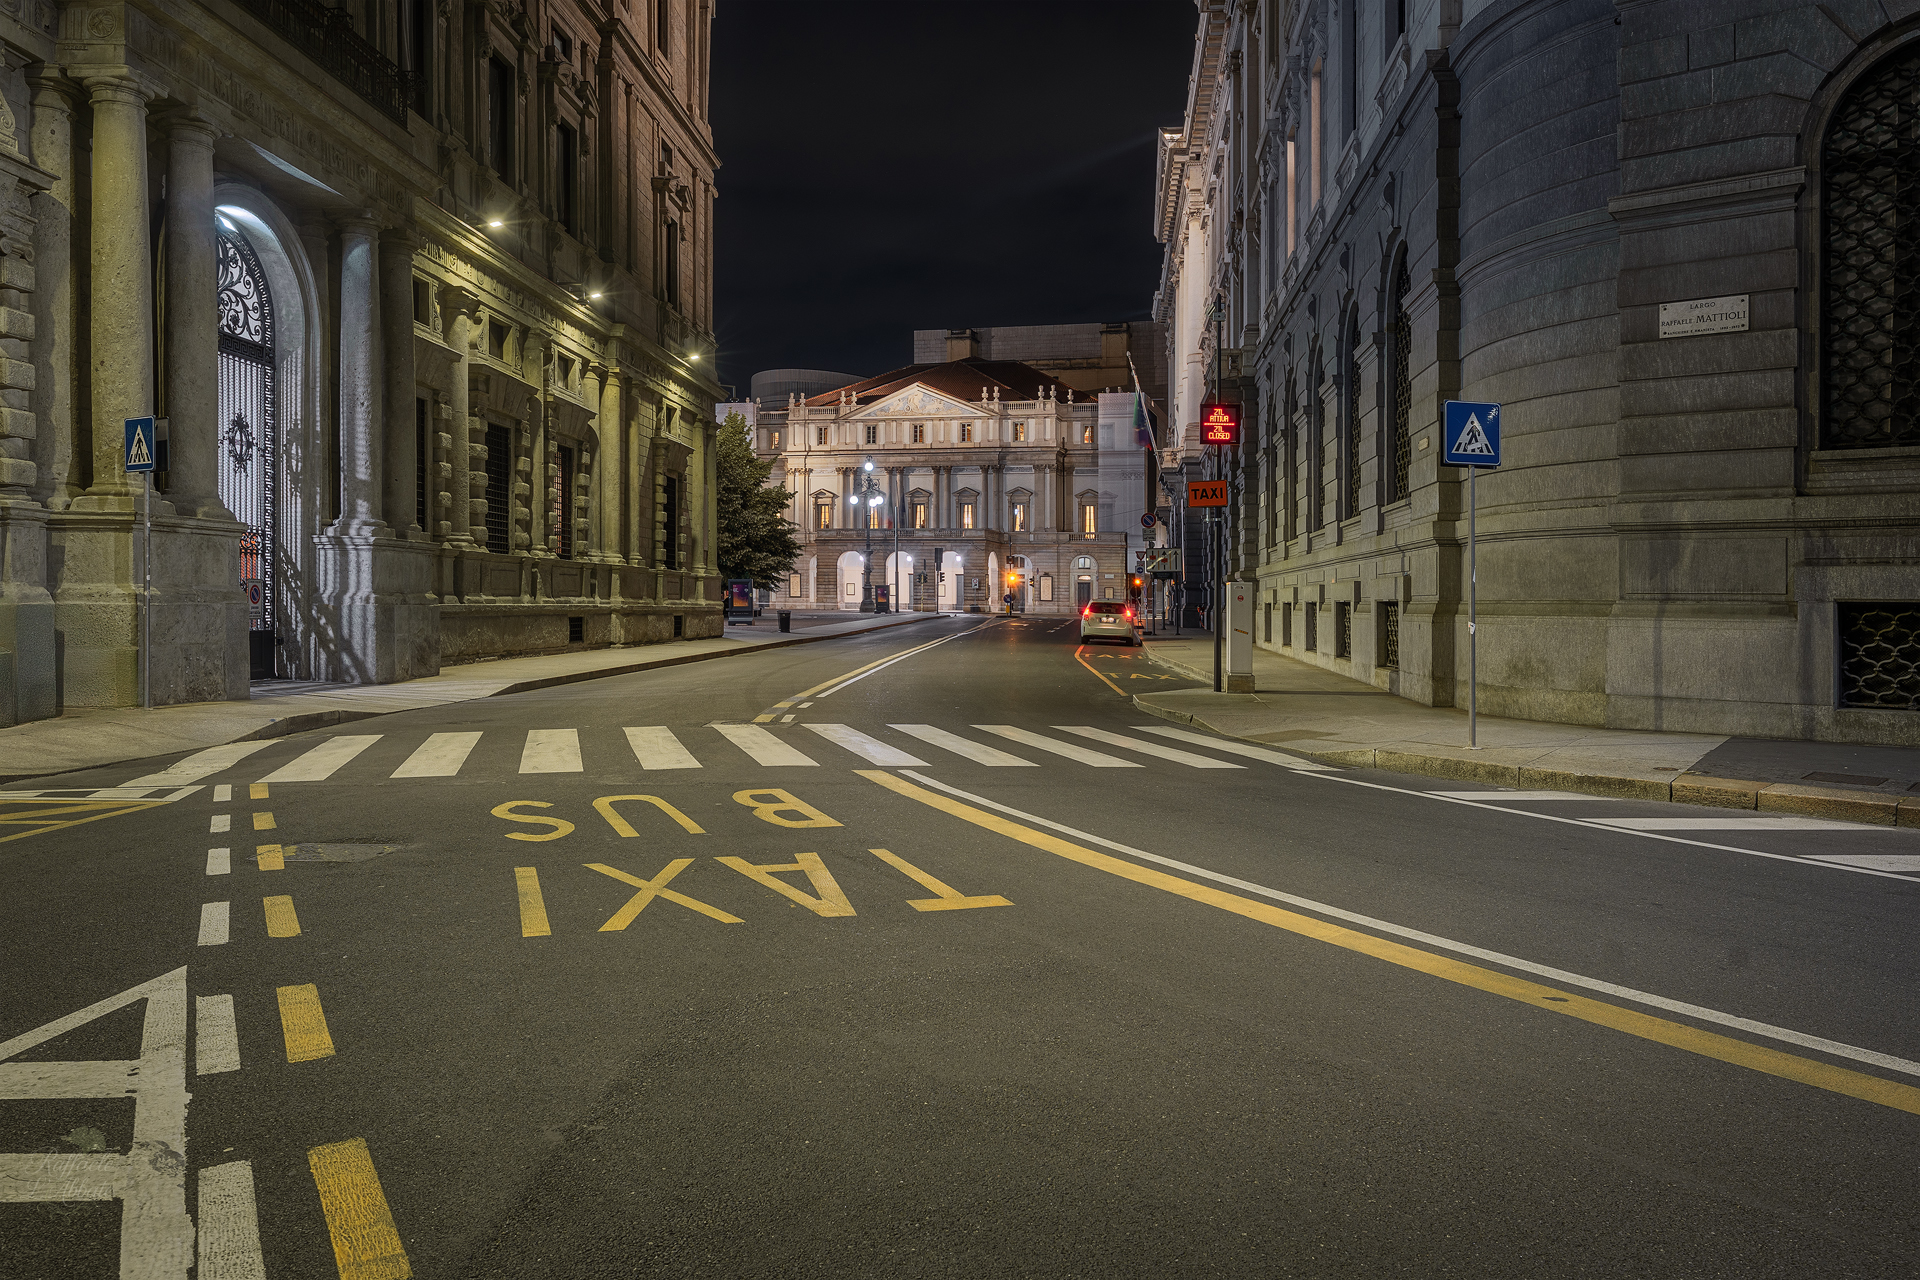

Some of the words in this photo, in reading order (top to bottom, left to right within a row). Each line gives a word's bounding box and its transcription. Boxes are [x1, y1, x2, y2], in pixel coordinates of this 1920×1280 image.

[1661, 319, 1693, 327] RAFFAELE
[1696, 311, 1746, 323] MATTIOLI
[1208, 432, 1231, 440] CLOSED
[1191, 487, 1223, 500] TAXI
[1102, 672, 1195, 681] TAXI
[491, 789, 845, 842] BUS
[514, 848, 1016, 937] TAXI
